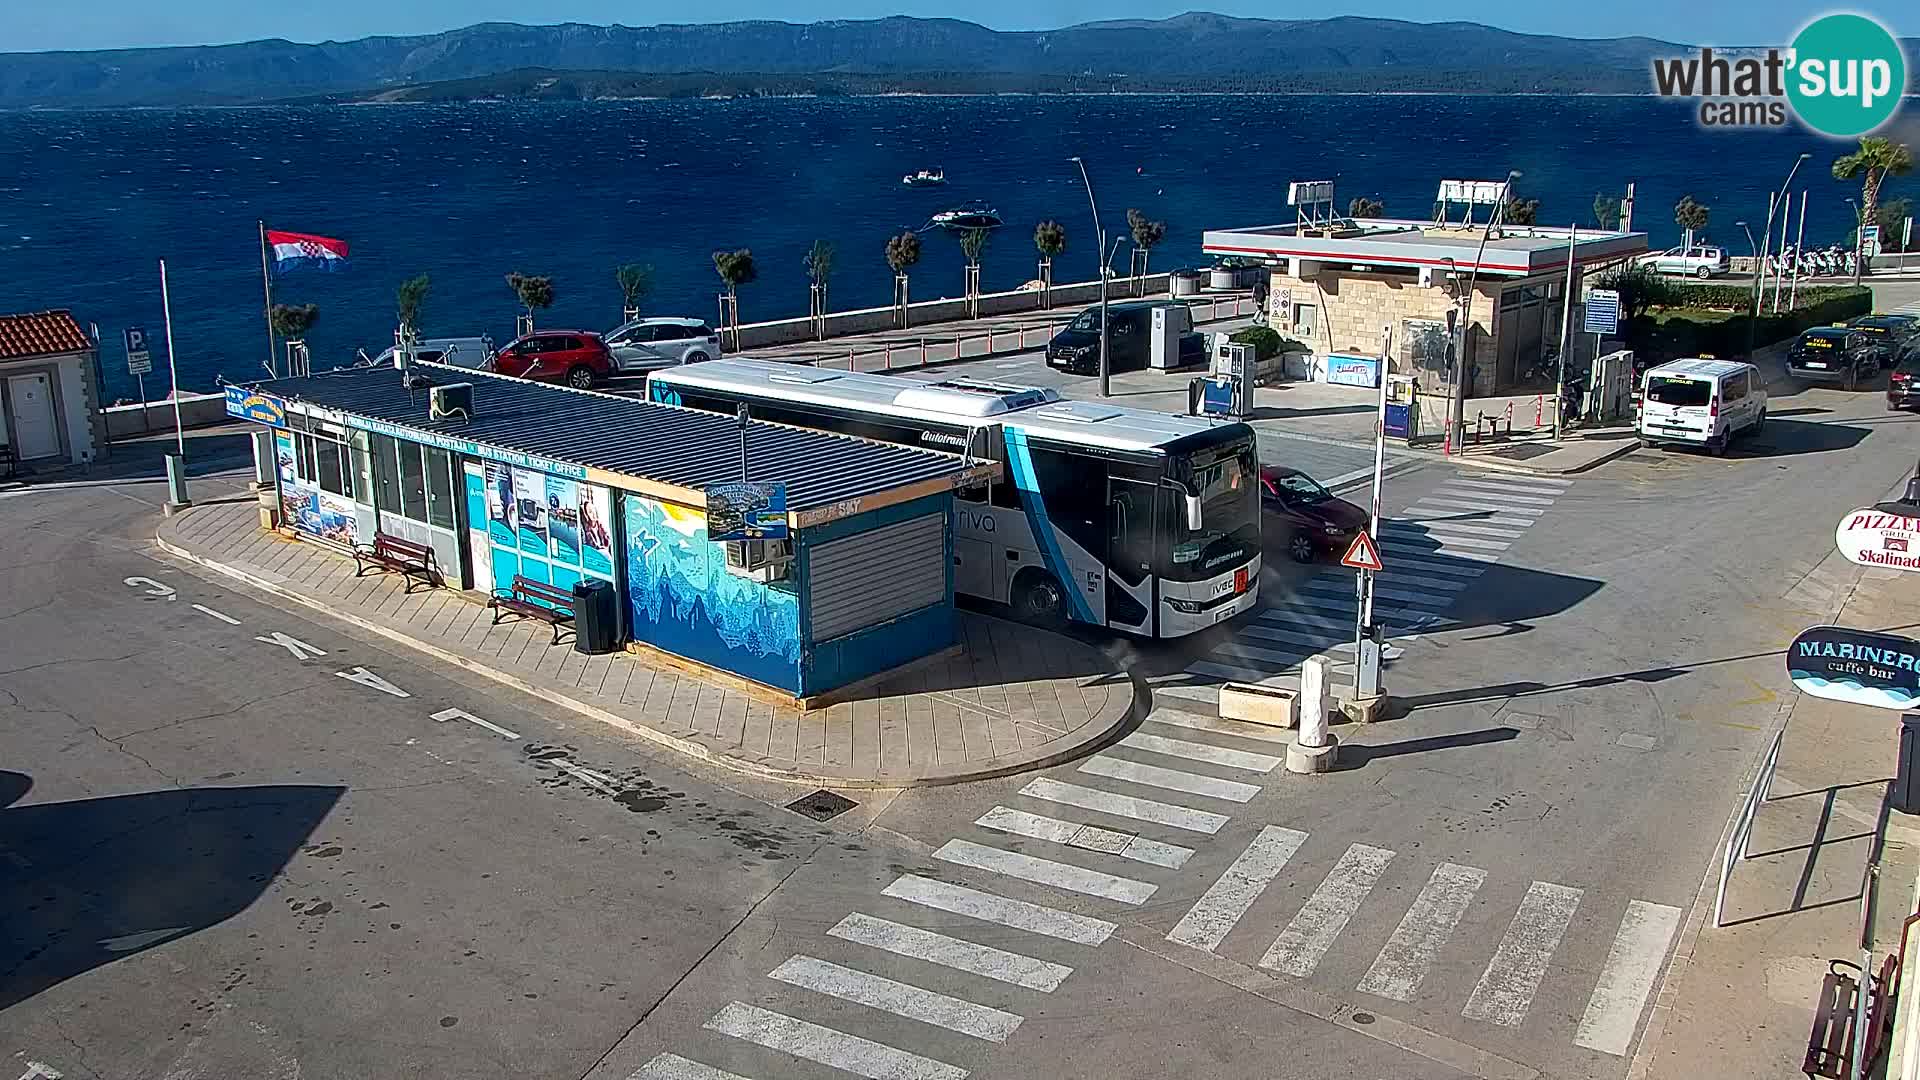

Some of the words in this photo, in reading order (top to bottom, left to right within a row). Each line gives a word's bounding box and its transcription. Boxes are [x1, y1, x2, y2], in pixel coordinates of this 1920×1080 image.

[130, 331, 143, 349] P
[921, 430, 967, 447] Autotrans
[495, 448, 526, 465] STATION
[528, 457, 554, 471] TICKET
[555, 462, 582, 476] OFFICE
[1880, 530, 1915, 539] GRILL
[1213, 580, 1233, 595] IVEC
[1828, 661, 1864, 674] caffe
[1868, 664, 1896, 680] bar
